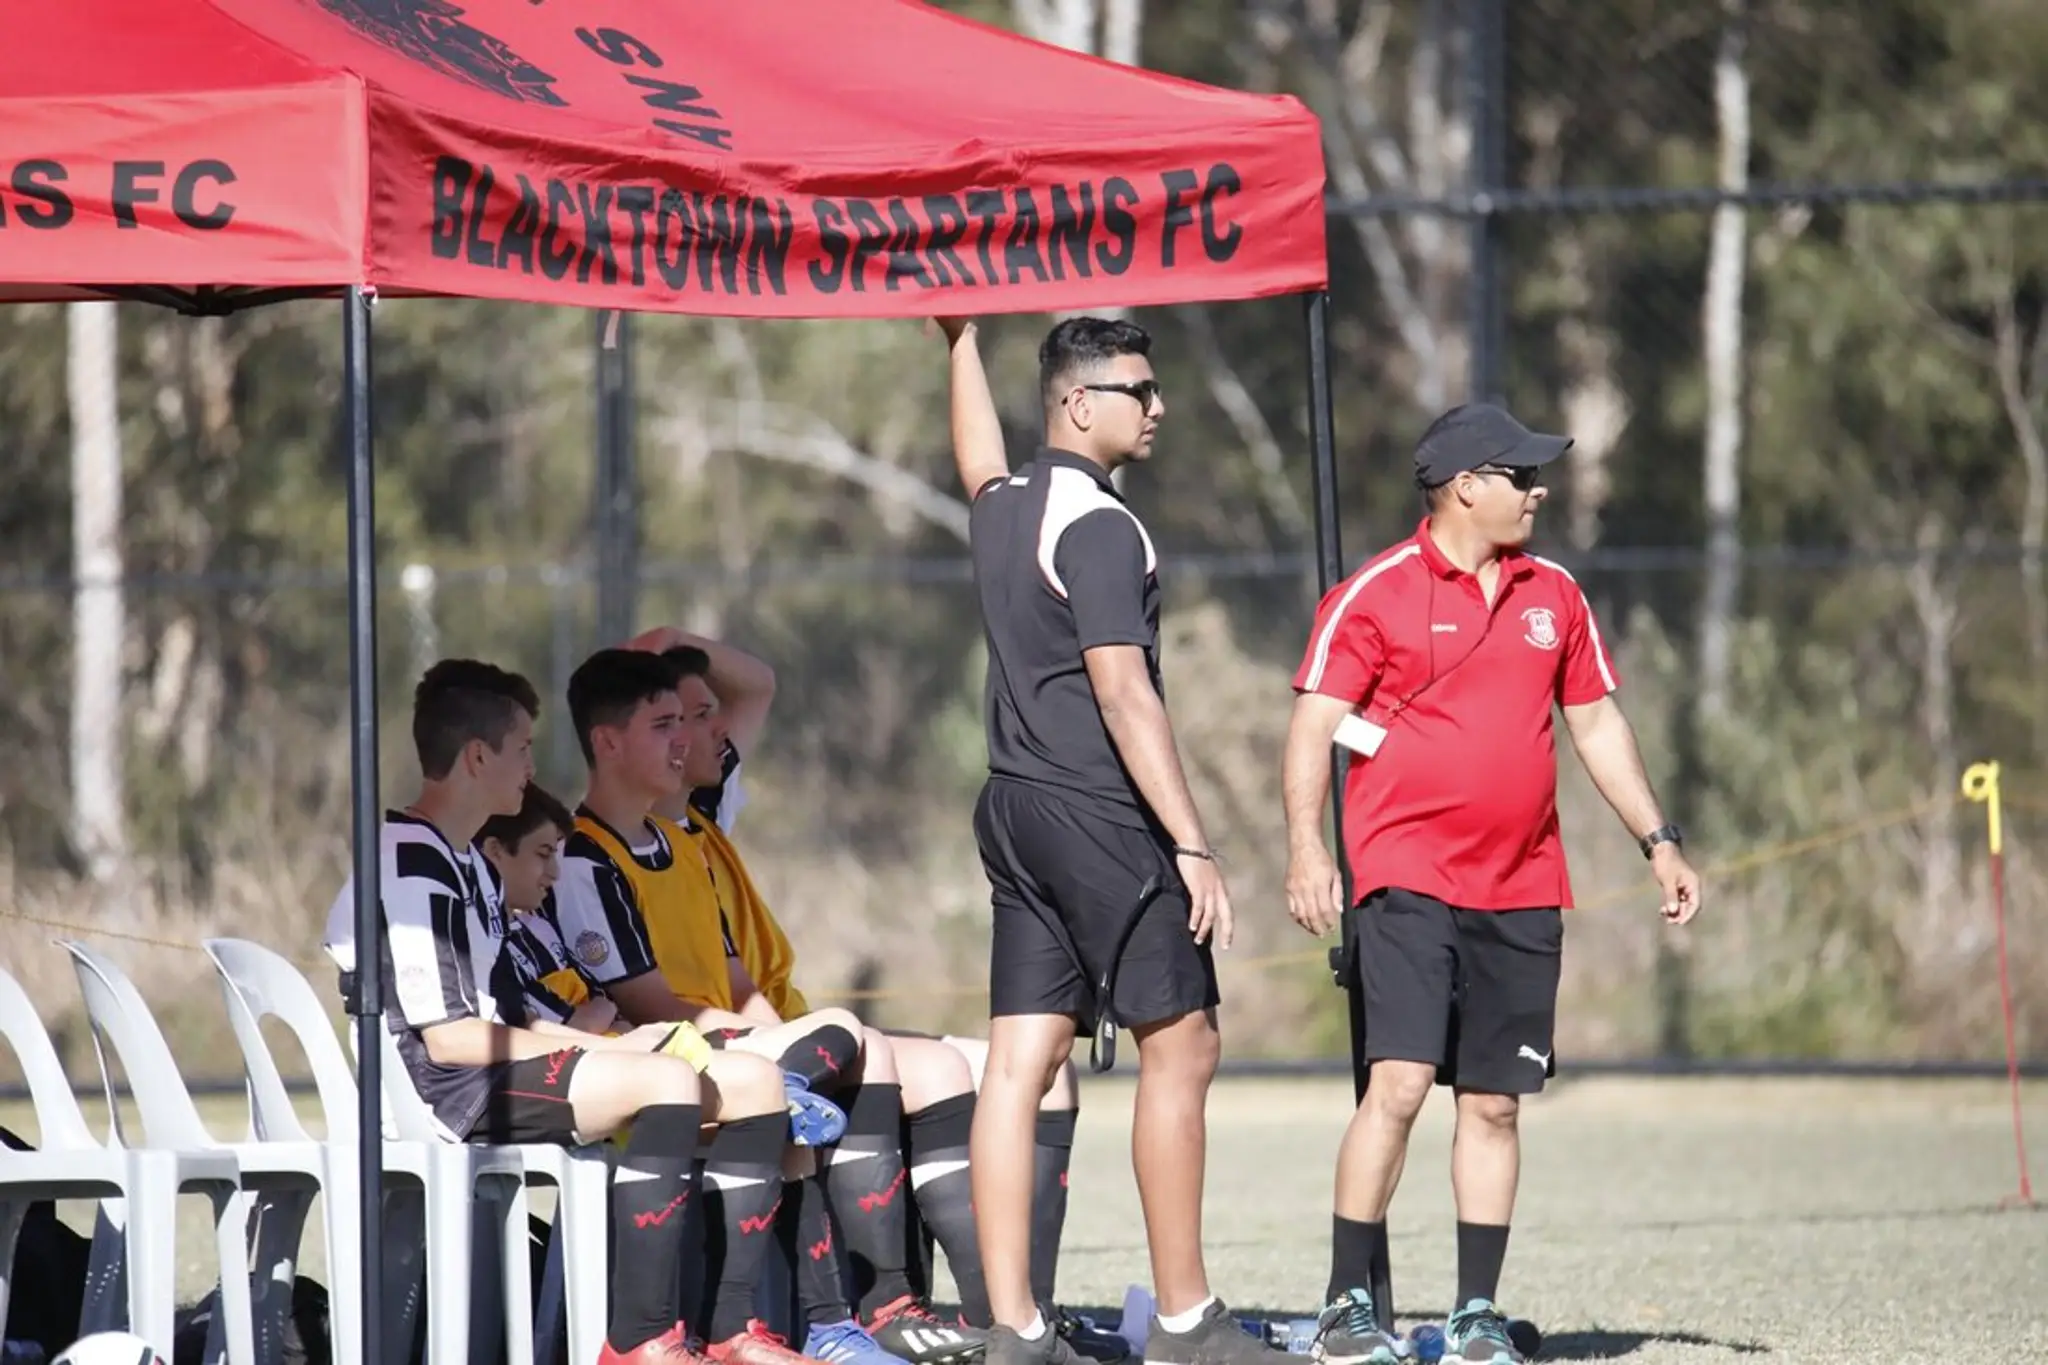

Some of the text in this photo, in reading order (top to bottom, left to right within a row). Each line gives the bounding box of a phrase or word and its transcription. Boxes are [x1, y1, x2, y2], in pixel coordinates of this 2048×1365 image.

[0, 158, 239, 230] S FC
[431, 155, 1245, 296] BLACKTOWN SPARTANS FC
